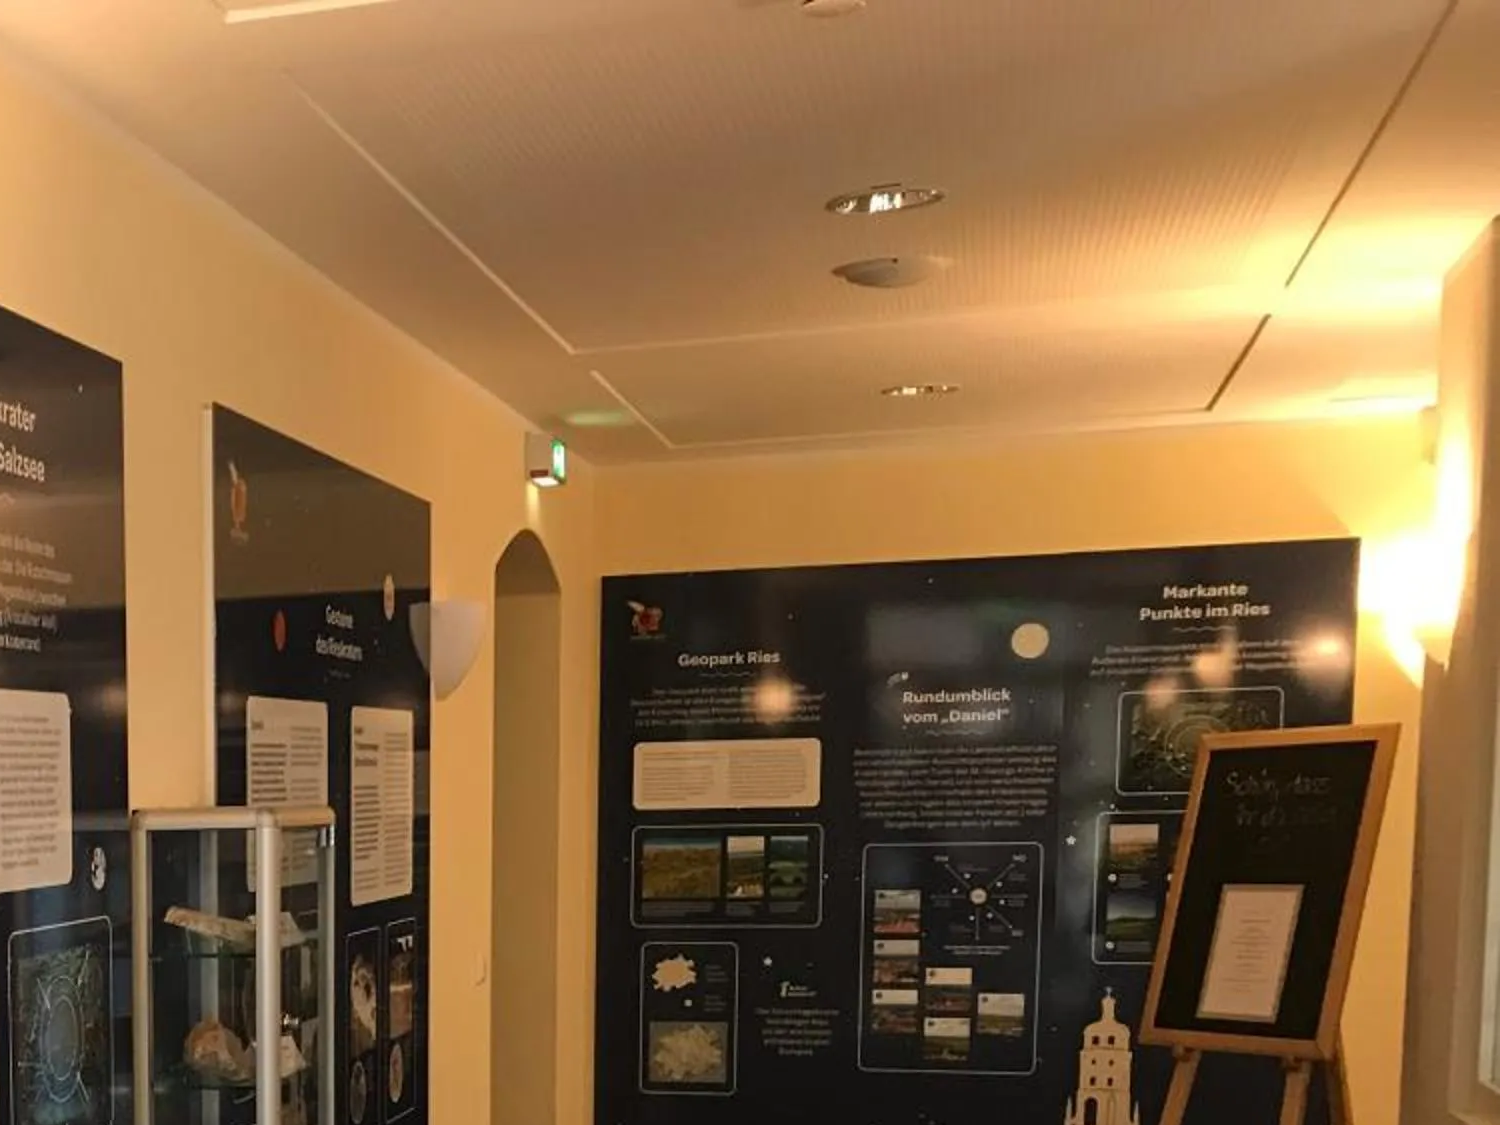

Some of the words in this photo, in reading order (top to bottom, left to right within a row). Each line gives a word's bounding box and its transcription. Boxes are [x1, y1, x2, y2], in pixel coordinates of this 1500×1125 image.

[1163, 583, 1249, 600] Markante
[1139, 605, 1203, 622] Punkte
[1206, 603, 1229, 619] im
[1232, 601, 1272, 617] Ries
[677, 650, 745, 669] Geopark
[747, 650, 781, 665] Ries
[902, 687, 1012, 704] Rundumblick
[903, 712, 938, 724] vom
